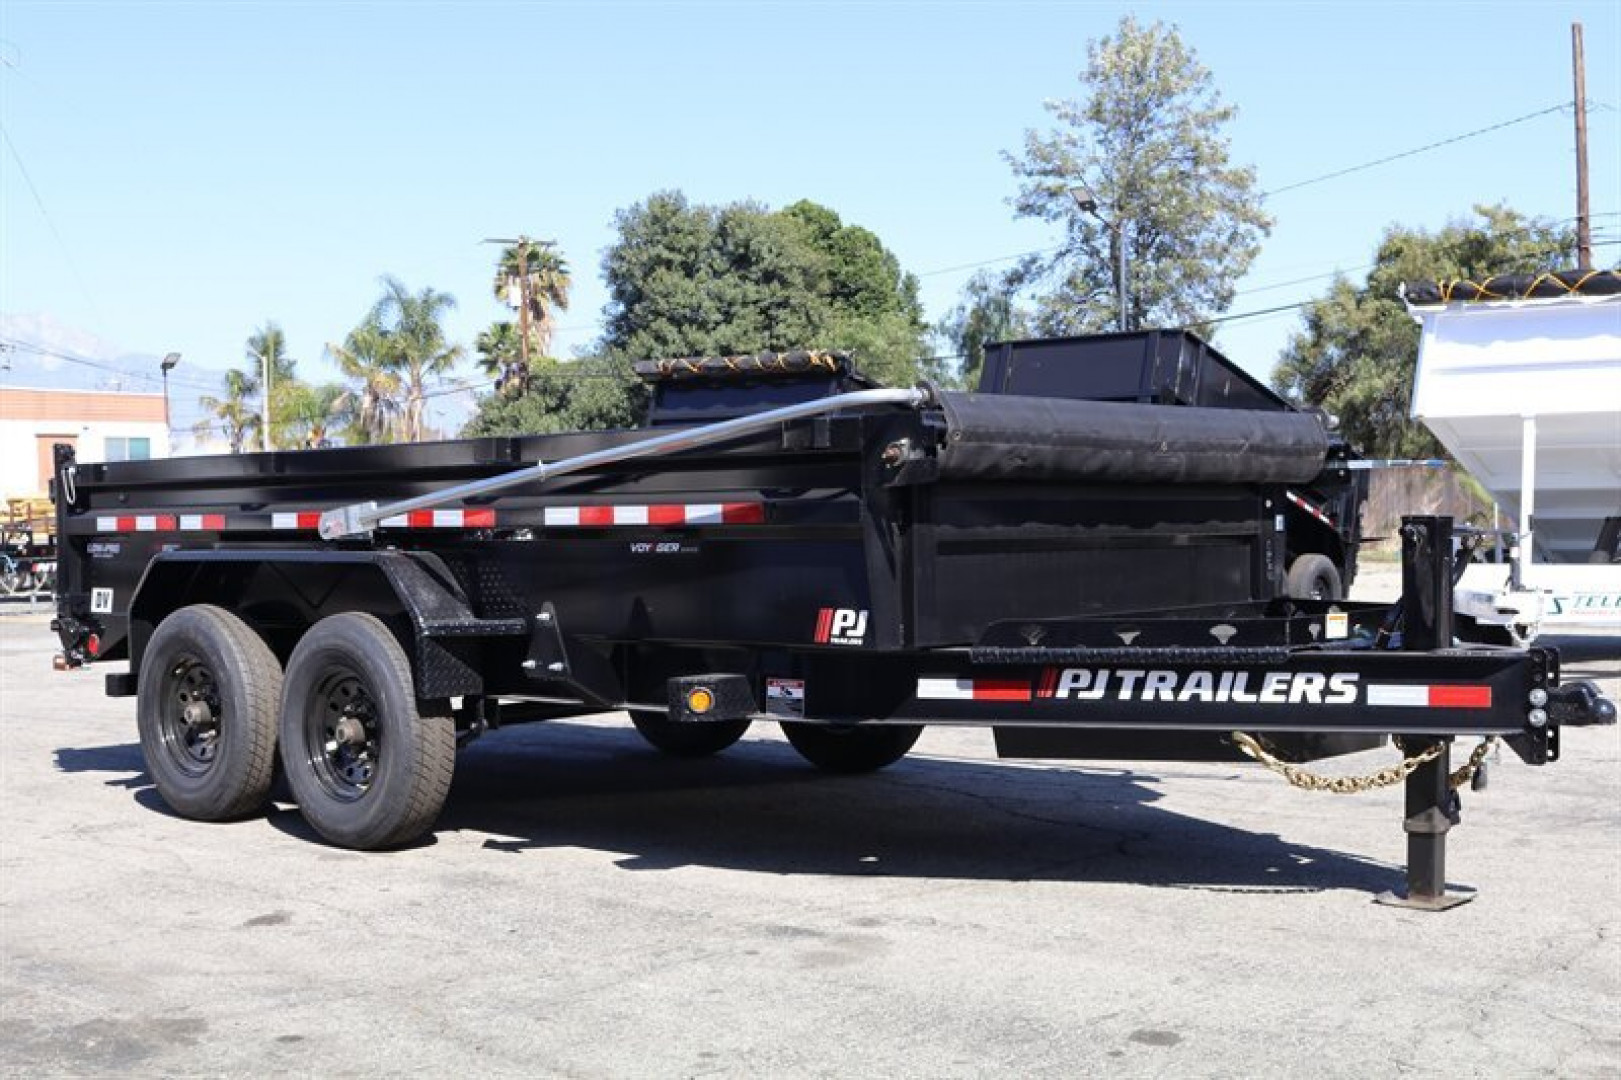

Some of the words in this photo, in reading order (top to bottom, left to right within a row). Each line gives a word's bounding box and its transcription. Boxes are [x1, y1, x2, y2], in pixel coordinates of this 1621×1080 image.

[832, 608, 868, 637] PJ
[1055, 668, 1110, 700] PJ
[1116, 670, 1360, 704] TRAILERS
